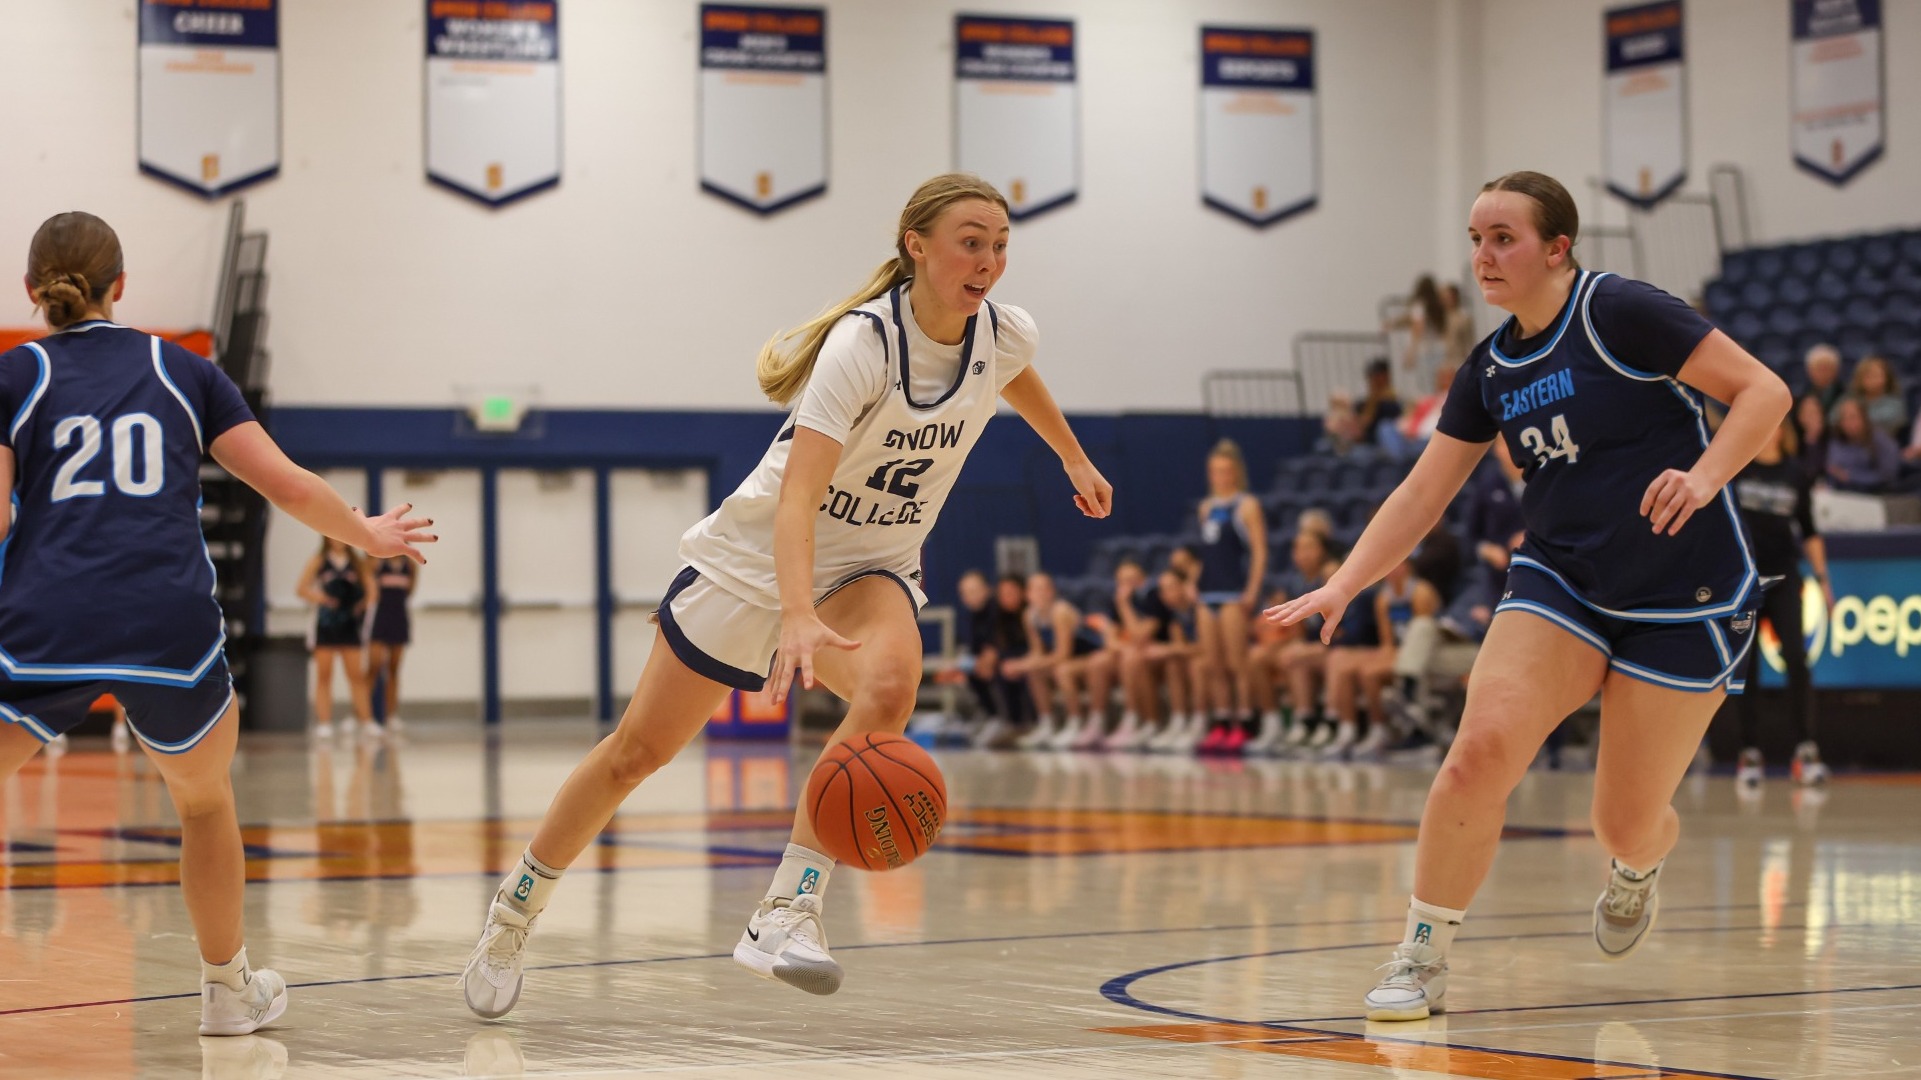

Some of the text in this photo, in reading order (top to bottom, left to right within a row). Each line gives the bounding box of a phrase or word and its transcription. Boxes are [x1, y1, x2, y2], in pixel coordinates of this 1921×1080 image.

[173, 10, 244, 35] CHEER
[1500, 368, 1575, 421] EASTERN
[51, 412, 164, 502] 20
[882, 420, 965, 450] SNOW
[1520, 414, 1579, 469] 34
[865, 458, 935, 499] 12
[1831, 594, 1921, 657] pep
